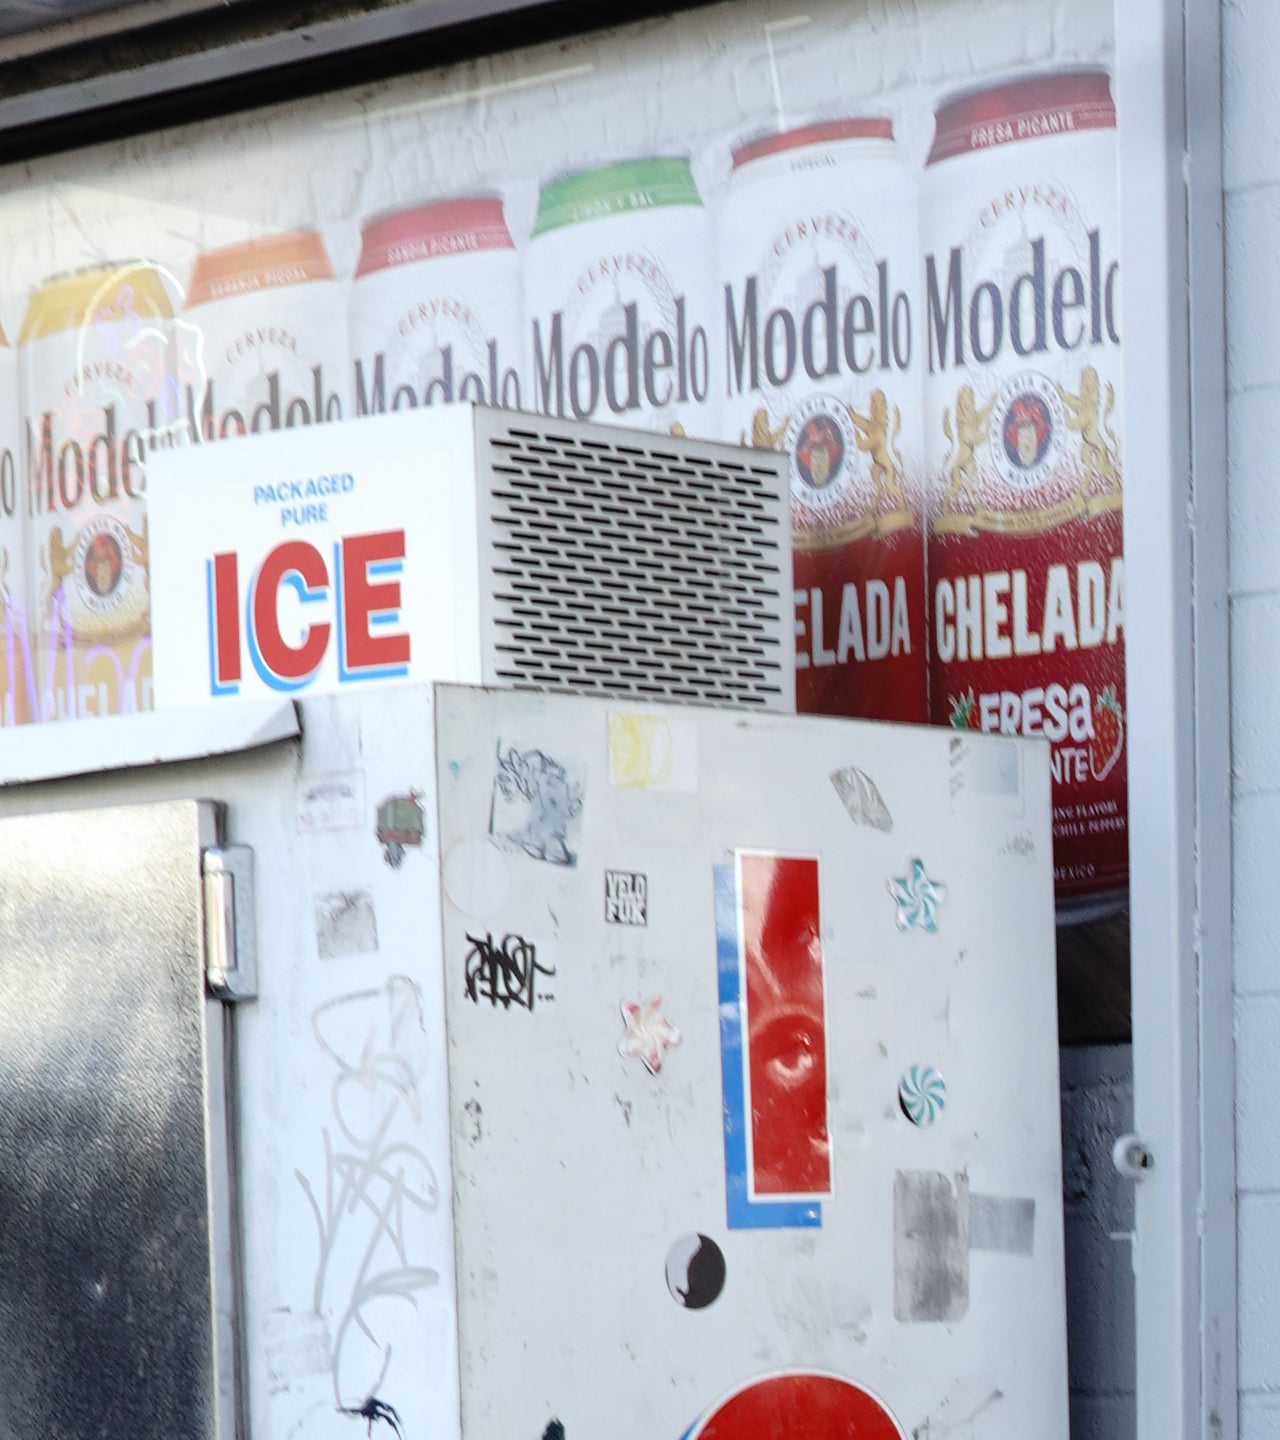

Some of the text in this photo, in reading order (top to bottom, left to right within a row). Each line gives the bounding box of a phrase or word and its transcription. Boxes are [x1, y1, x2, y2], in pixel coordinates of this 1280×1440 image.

[532, 295, 709, 421] Modelo
[723, 255, 912, 399] Modelo
[253, 472, 355, 507] PACKAGED
[280, 502, 329, 527] PURE
[205, 528, 412, 696] ICE
[794, 576, 911, 670] ELADA
[935, 557, 1125, 664] CHELADA
